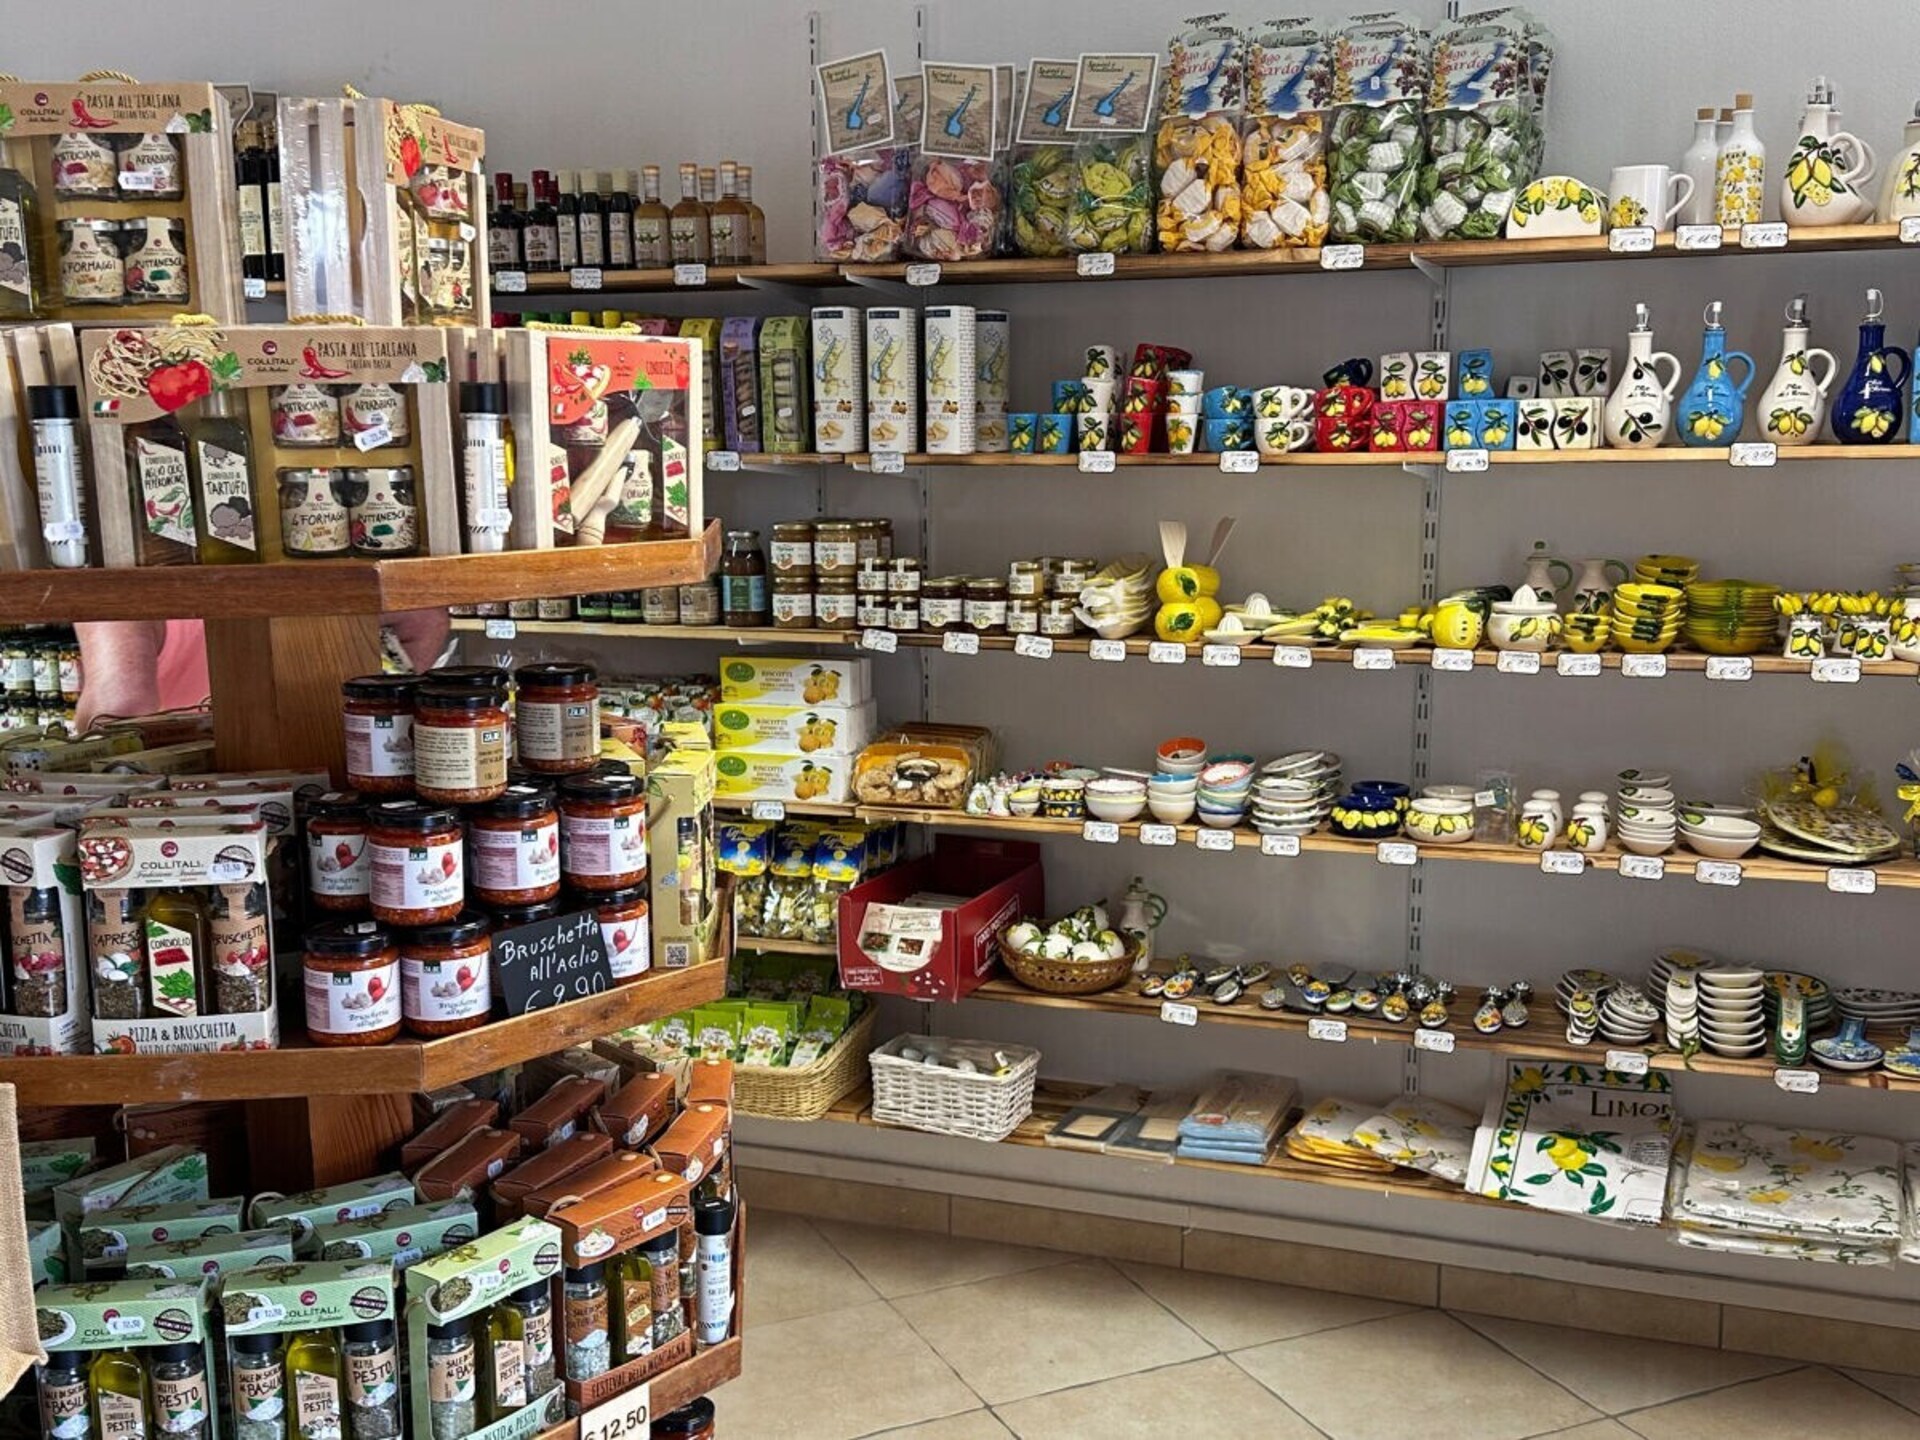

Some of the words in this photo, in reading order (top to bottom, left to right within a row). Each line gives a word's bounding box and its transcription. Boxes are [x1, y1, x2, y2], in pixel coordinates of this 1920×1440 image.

[87, 94, 114, 108] PASTA
[68, 259, 117, 274] FORMAGGI
[317, 342, 346, 357] PASTA
[350, 341, 417, 358] ALL'ITALIANA
[248, 358, 295, 366] COLLITALI
[205, 481, 247, 496] TARTUFO
[141, 860, 200, 869] COLLITALI
[129, 1026, 157, 1043] PIZZA
[161, 1029, 169, 1041] &
[173, 1021, 237, 1041] BRUSCHETTA
[527, 1327, 546, 1345] PES
[352, 1360, 393, 1384] PESTO
[158, 1386, 199, 1409] PESTO
[303, 1400, 333, 1414] PESTO
[106, 1420, 137, 1433] PESTO
[507, 1426, 513, 1437] &
[516, 1408, 538, 1431] PESTO
[600, 1404, 648, 1438] 12,50
